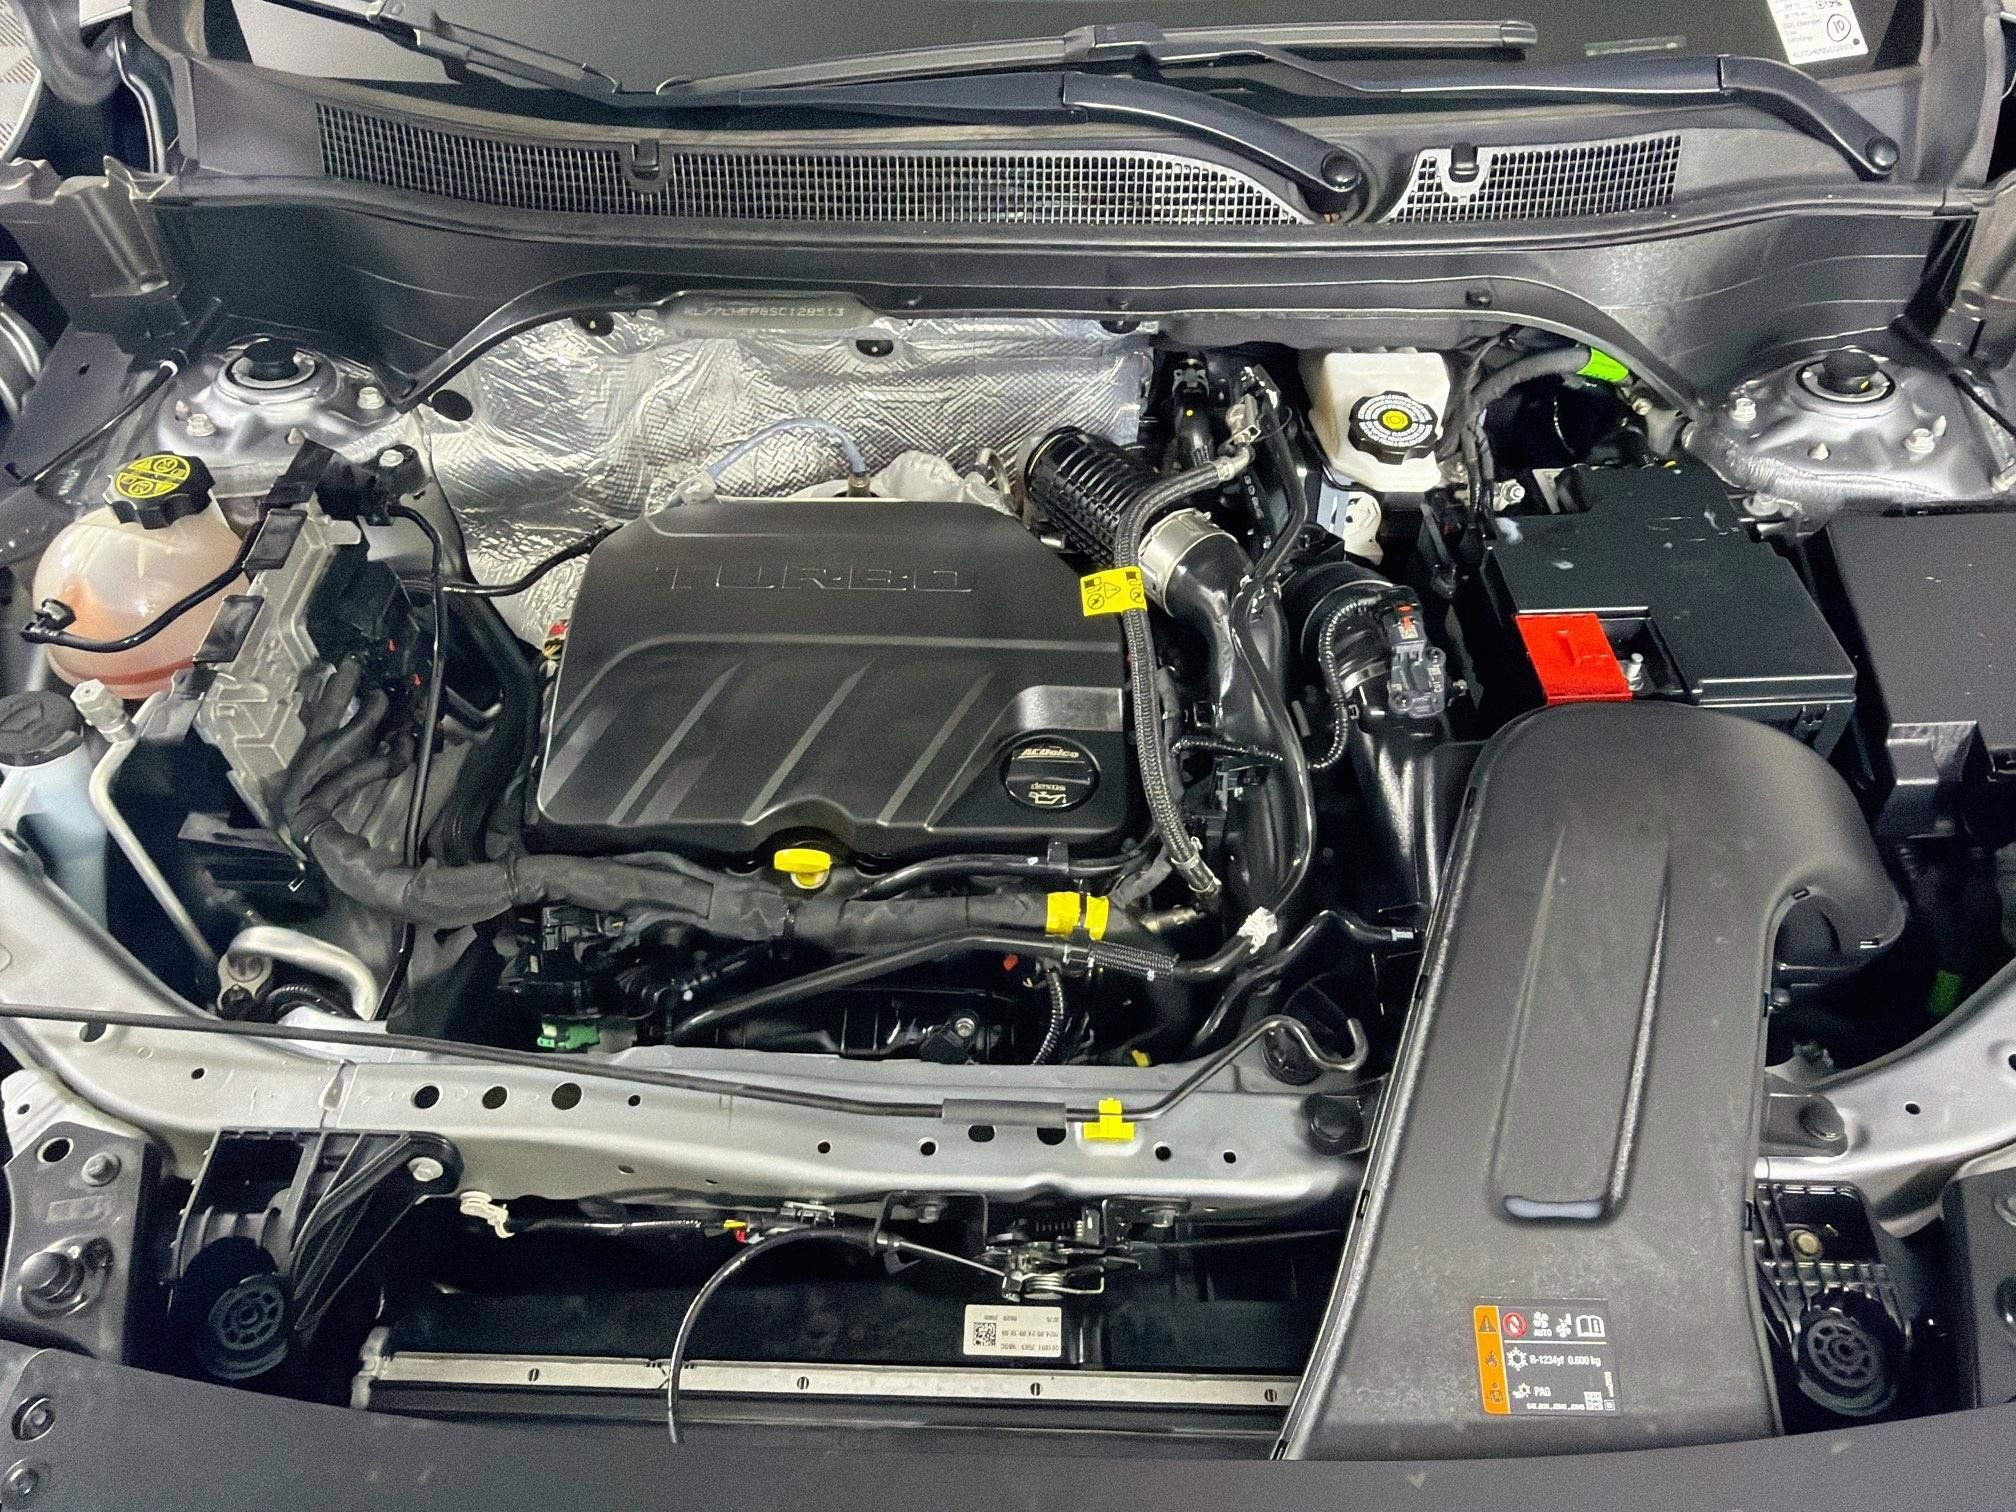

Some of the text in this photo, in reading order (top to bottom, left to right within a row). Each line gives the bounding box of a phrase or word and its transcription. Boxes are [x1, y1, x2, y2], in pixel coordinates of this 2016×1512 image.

[655, 561, 973, 593] TURBO
[1021, 747, 1080, 758] ACDelco
[1533, 1328, 1553, 1337] AUTO
[1529, 1354, 1565, 1367] R-1234yf
[1590, 1355, 1602, 1368] kg
[1533, 1386, 1552, 1397] PAG
